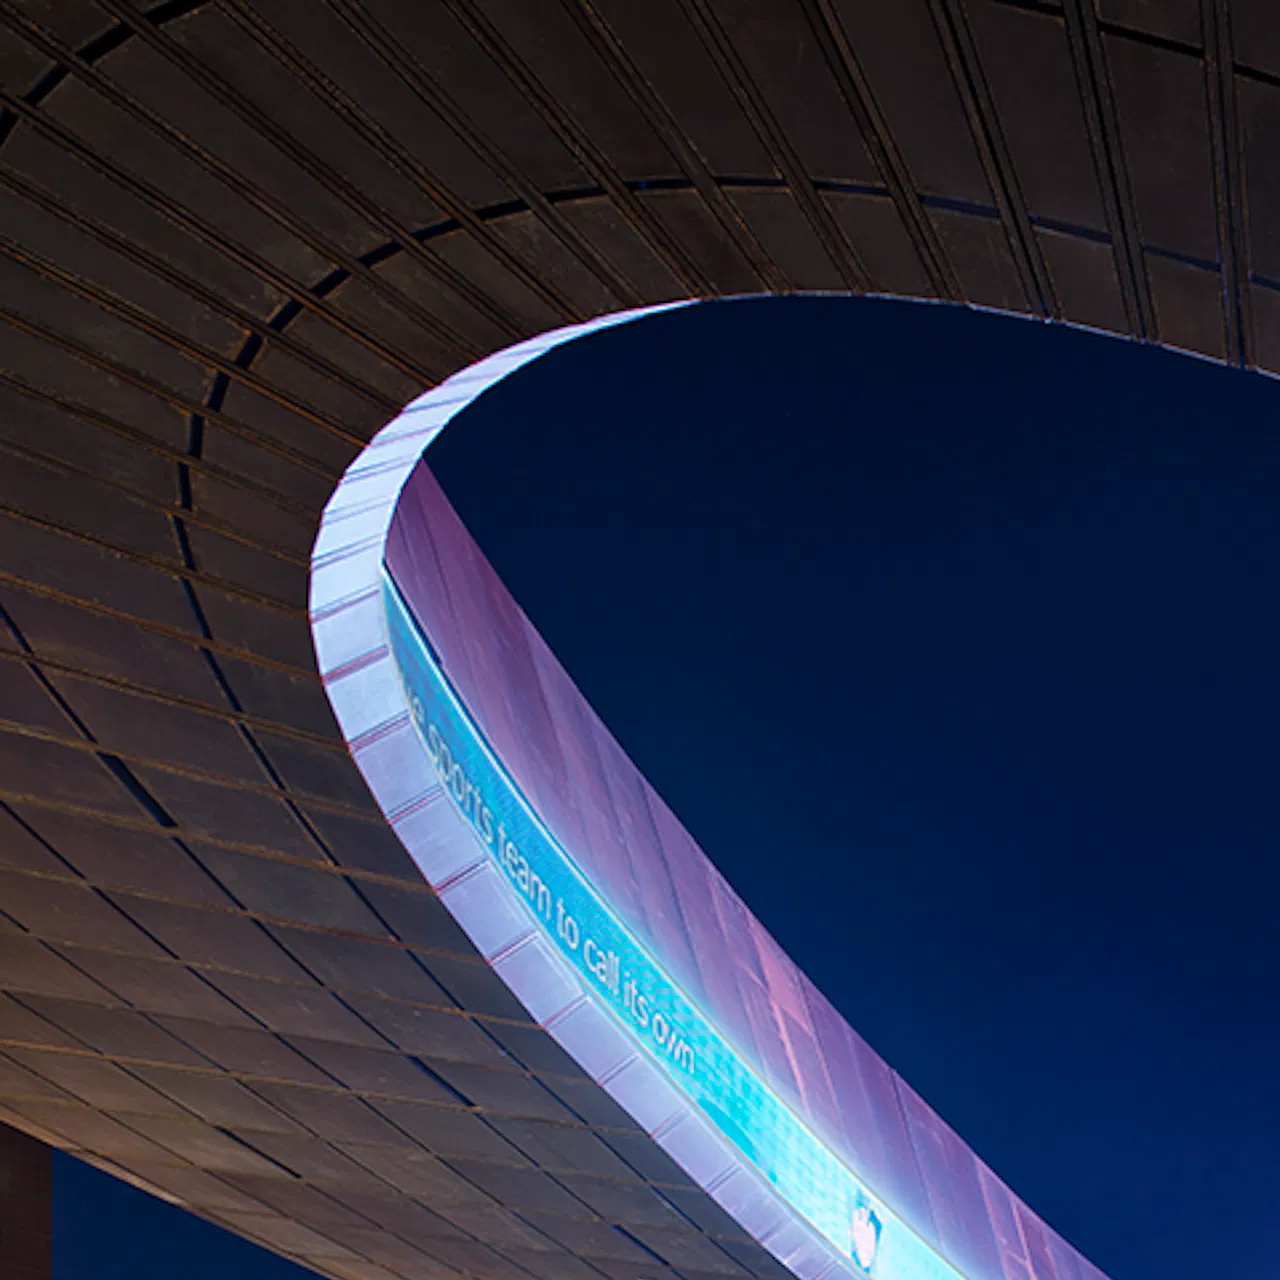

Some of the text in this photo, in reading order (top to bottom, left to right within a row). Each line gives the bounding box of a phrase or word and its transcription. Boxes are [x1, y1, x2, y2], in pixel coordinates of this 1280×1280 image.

[497, 825, 552, 921] team
[556, 898, 580, 950] to
[583, 939, 621, 996] call
[623, 972, 649, 1028] its
[652, 1012, 695, 1075] own
